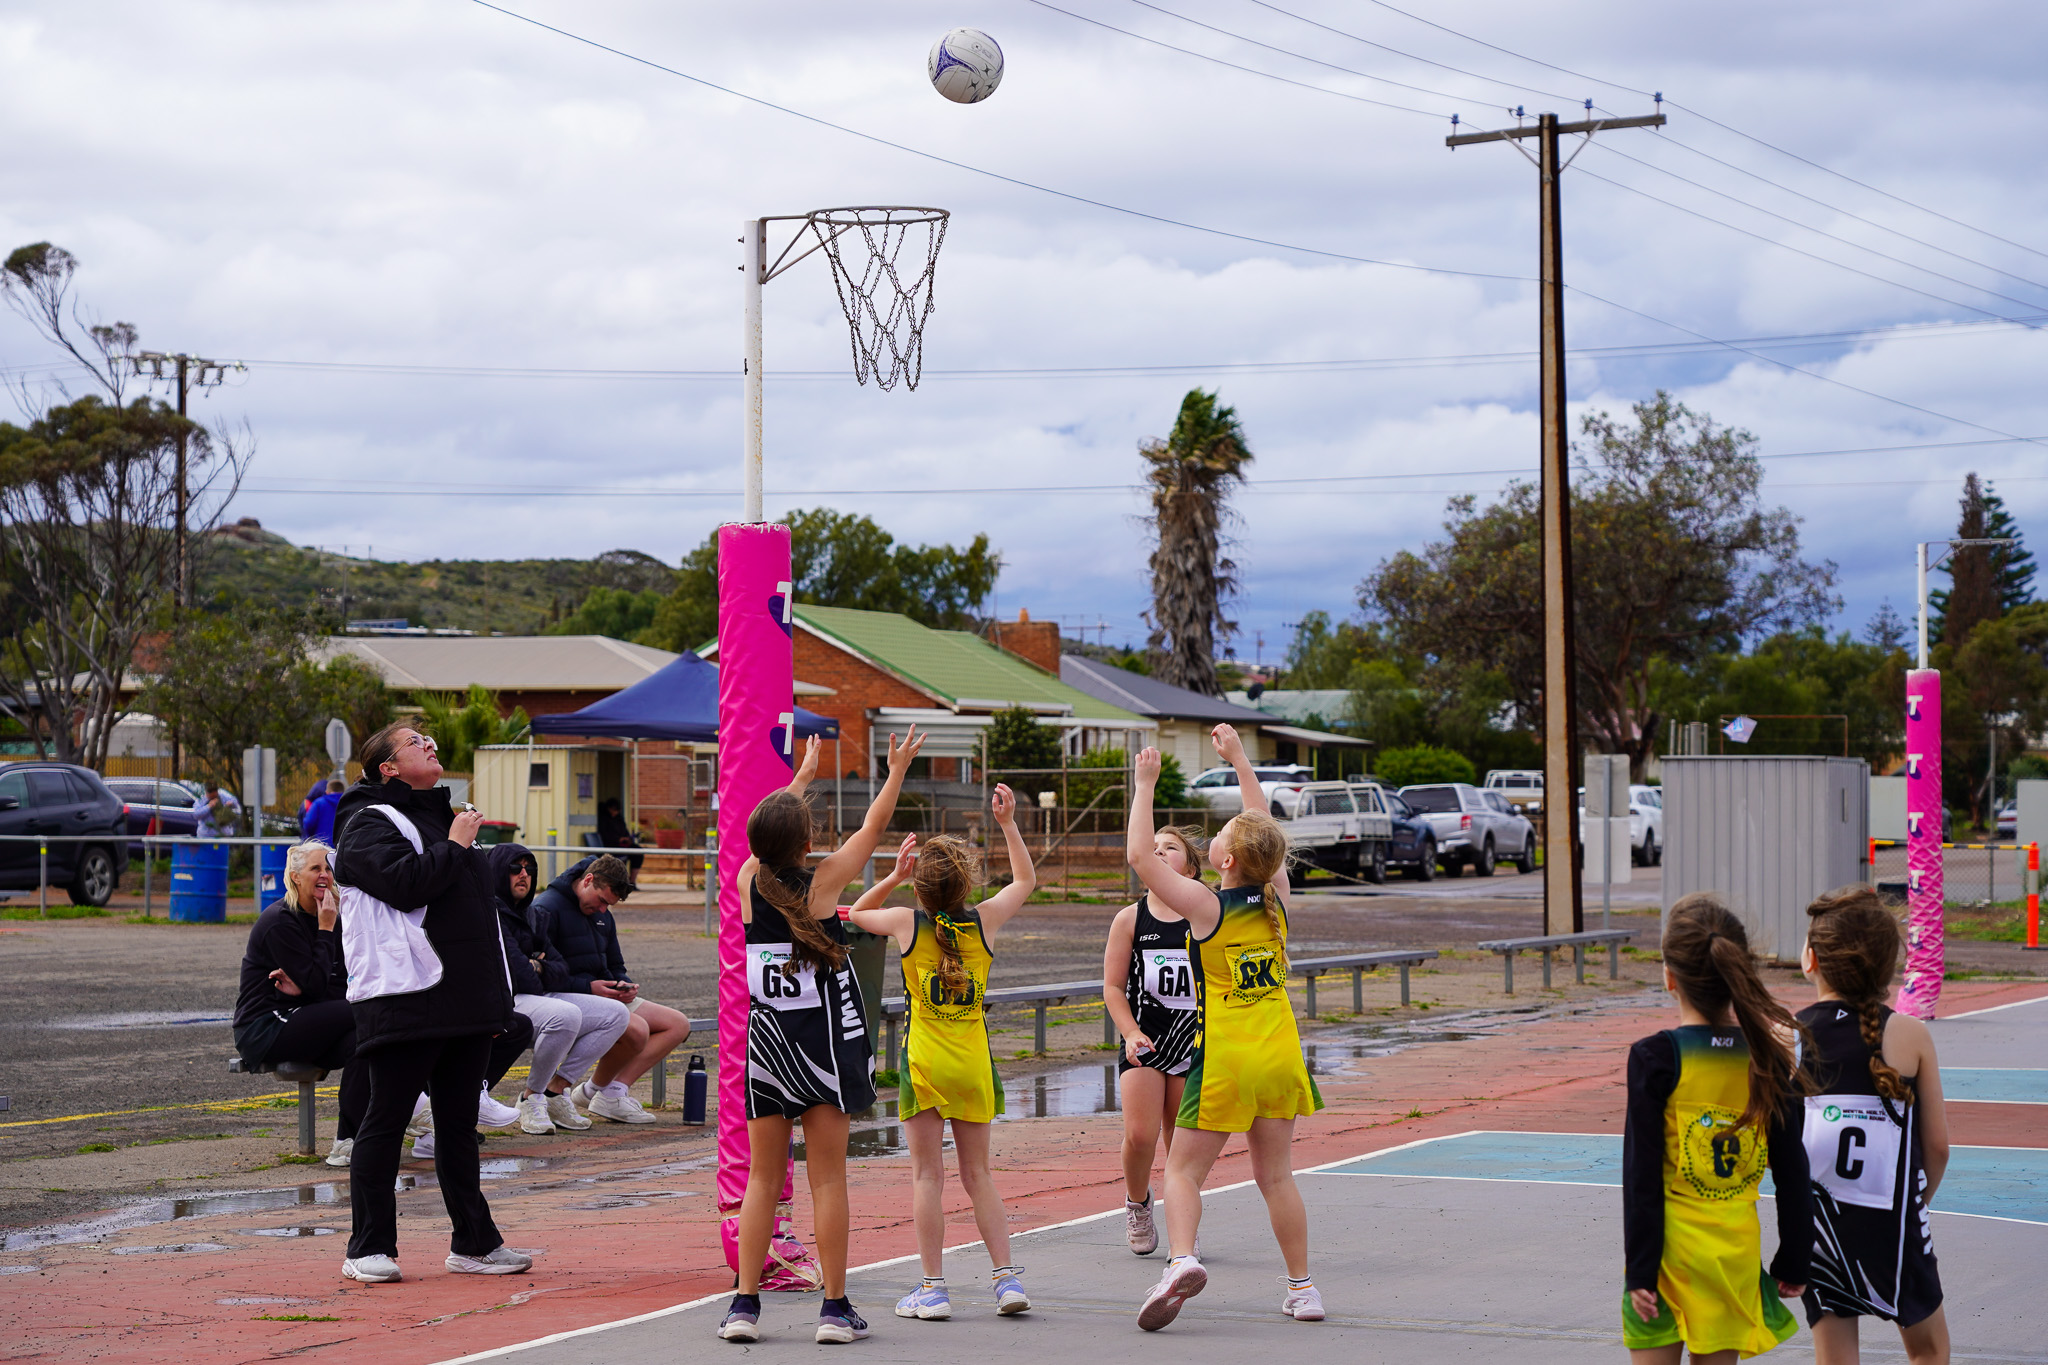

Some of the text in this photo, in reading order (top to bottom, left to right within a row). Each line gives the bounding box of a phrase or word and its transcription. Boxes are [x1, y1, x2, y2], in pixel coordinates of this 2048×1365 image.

[776, 580, 792, 623] T
[1908, 695, 1923, 715] T
[778, 712, 794, 754] T
[1908, 754, 1923, 774] T
[1909, 812, 1924, 832] T
[1910, 870, 1925, 889] T
[763, 964, 801, 998] GS
[1158, 966, 1190, 997] GA
[1238, 958, 1279, 989] GK
[1835, 1126, 1866, 1180] C
